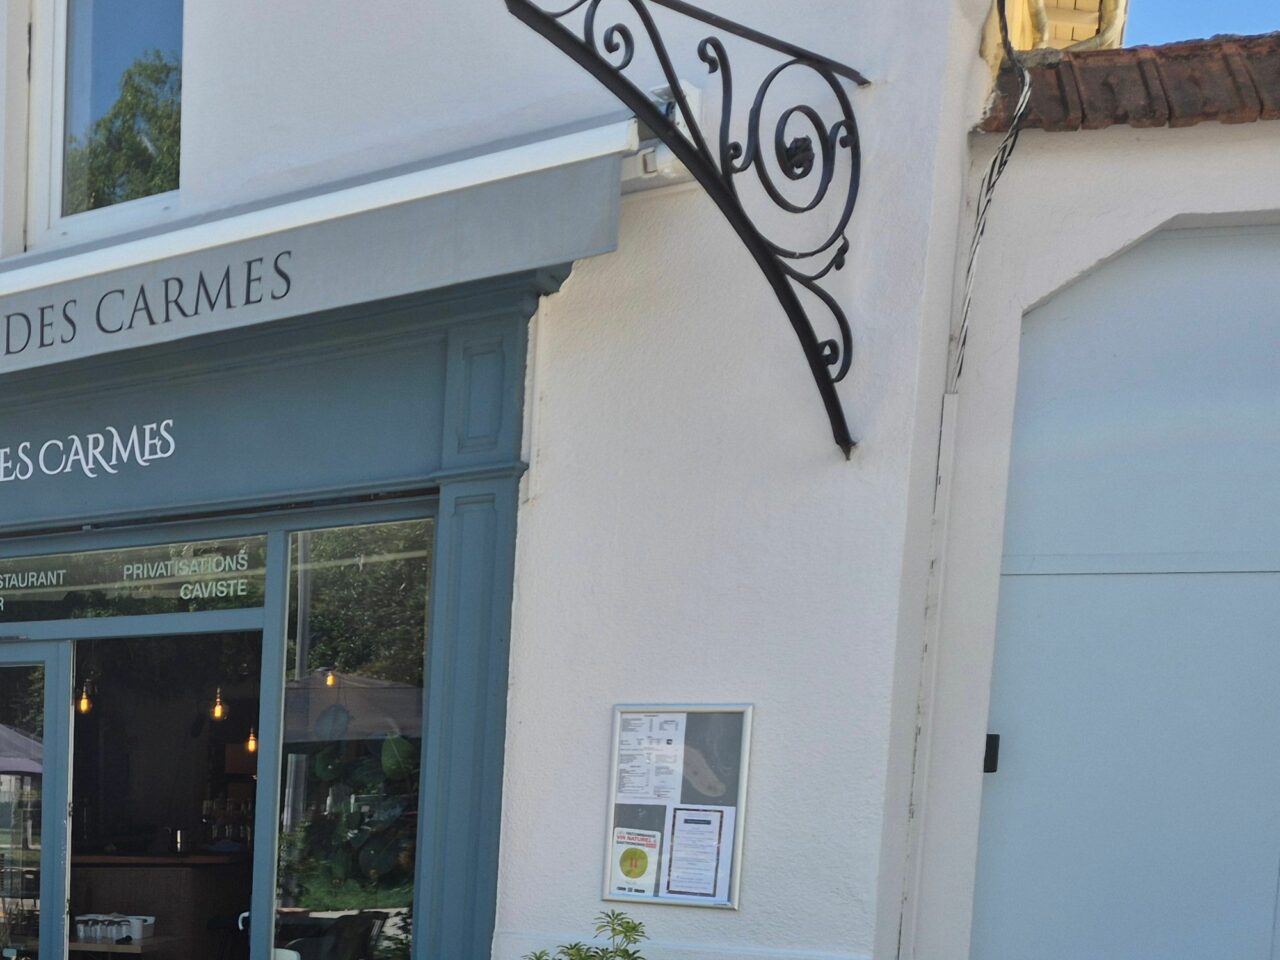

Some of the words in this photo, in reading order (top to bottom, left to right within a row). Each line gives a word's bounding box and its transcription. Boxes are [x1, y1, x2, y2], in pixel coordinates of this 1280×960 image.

[3, 298, 77, 356] DES
[95, 250, 292, 334] CARMES
[38, 419, 176, 478] CARMES
[123, 554, 249, 580] PRIVATISATIONS
[180, 579, 248, 601] CAVISTE
